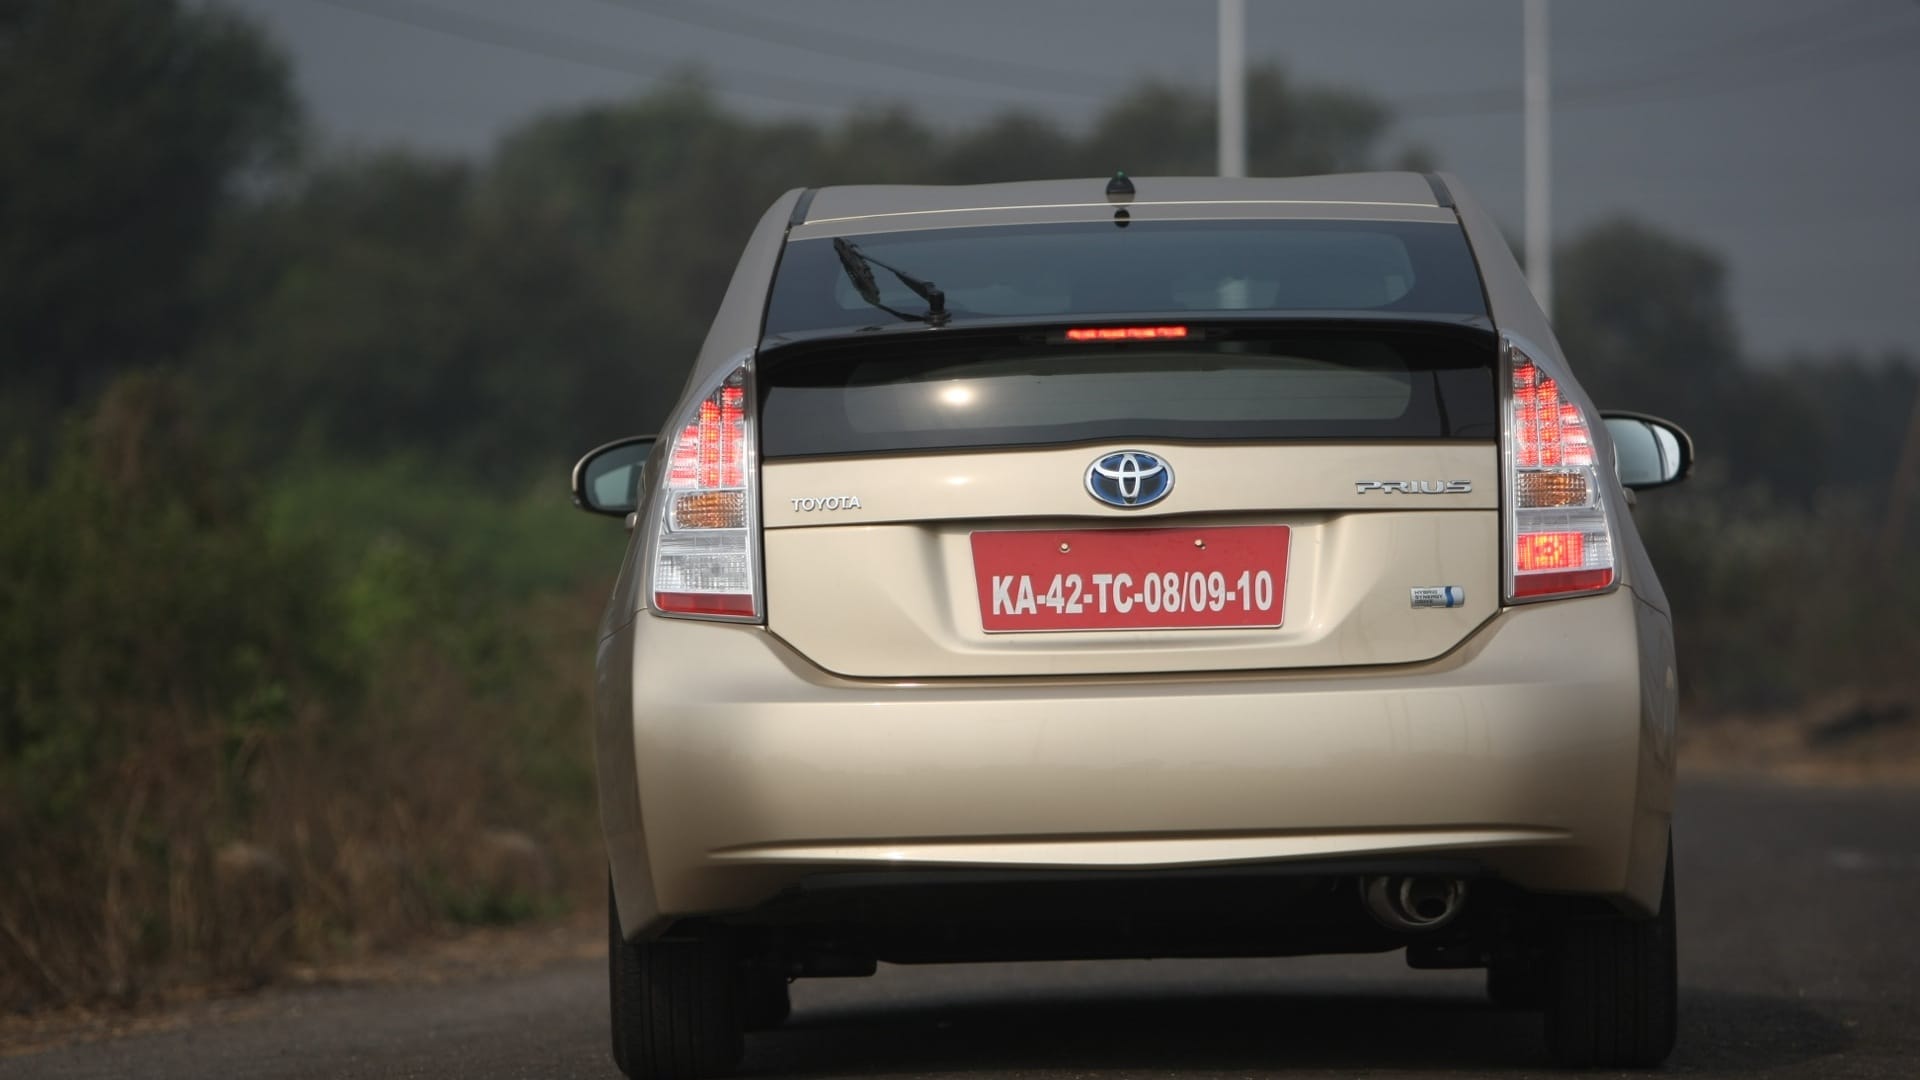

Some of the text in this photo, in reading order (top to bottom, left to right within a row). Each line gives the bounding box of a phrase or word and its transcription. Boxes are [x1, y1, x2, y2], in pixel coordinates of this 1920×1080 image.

[1355, 480, 1472, 494] PRIUS
[791, 496, 862, 512] TOYOTA
[992, 570, 1273, 615] KA-42-TC-08/09-10
